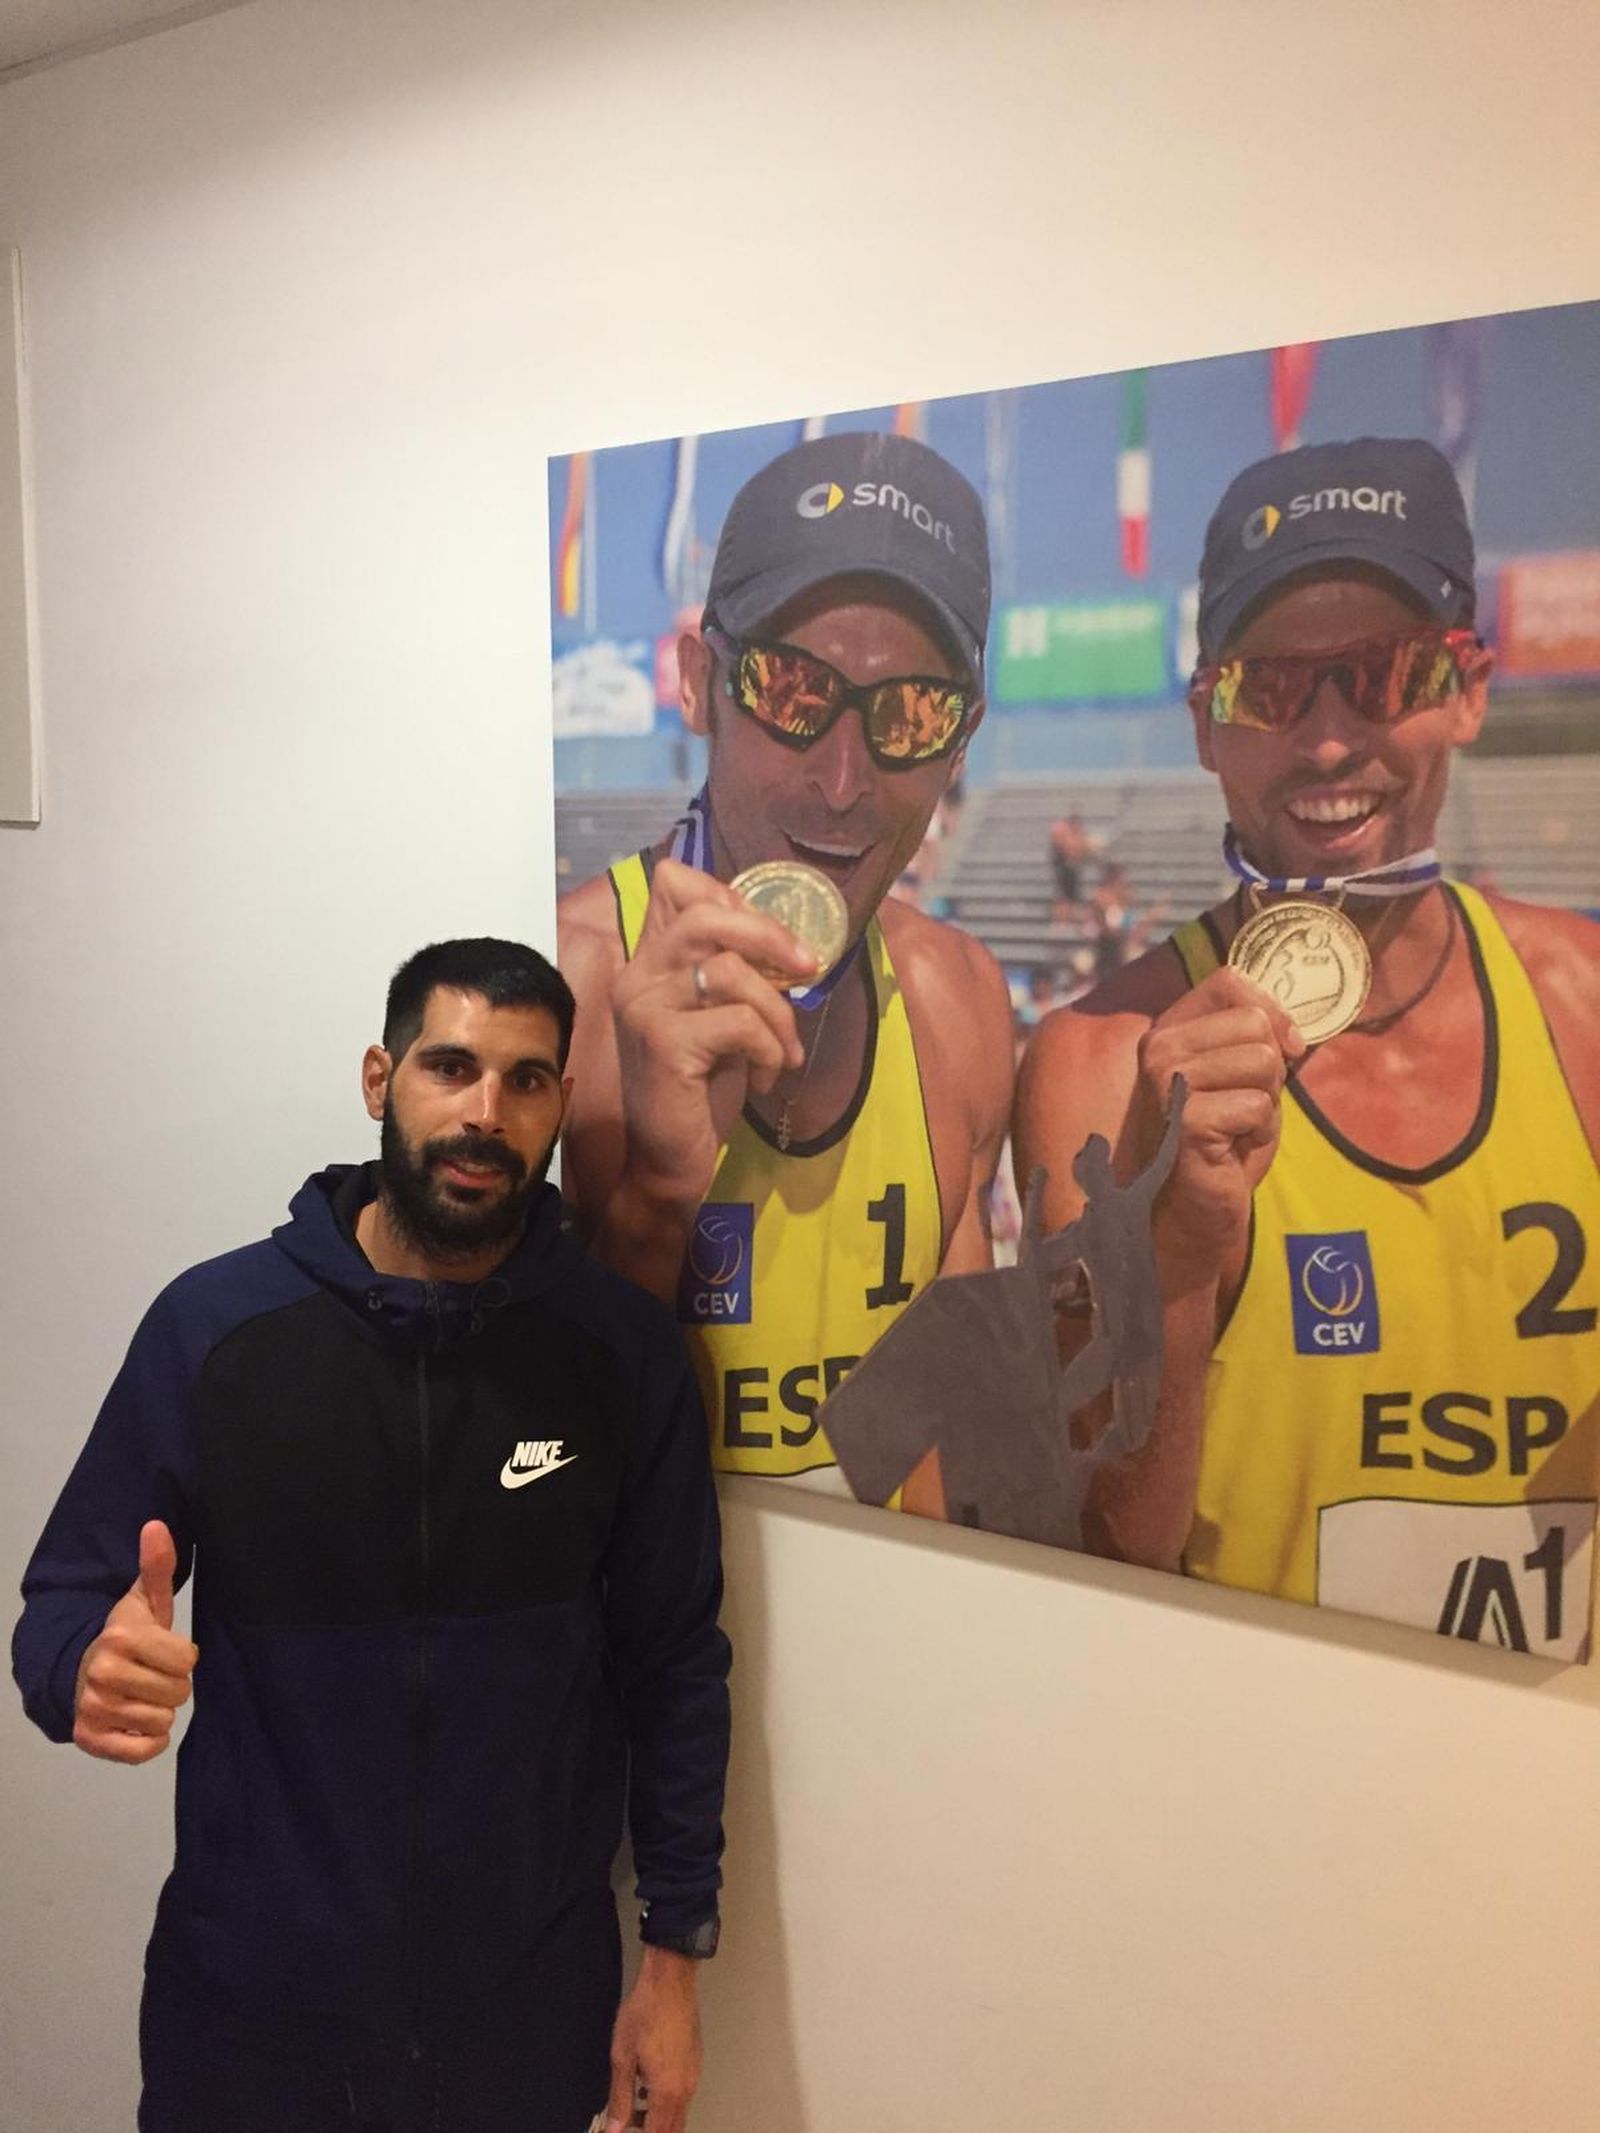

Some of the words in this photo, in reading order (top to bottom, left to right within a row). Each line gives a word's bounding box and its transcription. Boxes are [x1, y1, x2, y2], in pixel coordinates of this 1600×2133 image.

[853, 482, 956, 555] smart
[1288, 486, 1407, 520] smart
[866, 1183, 914, 1310] 1
[1501, 1201, 1598, 1340] 2
[694, 1292, 739, 1315] CEV
[1312, 1321, 1366, 1347] CEV
[511, 1440, 564, 1467] NIKE
[1360, 1391, 1569, 1477] ESP
